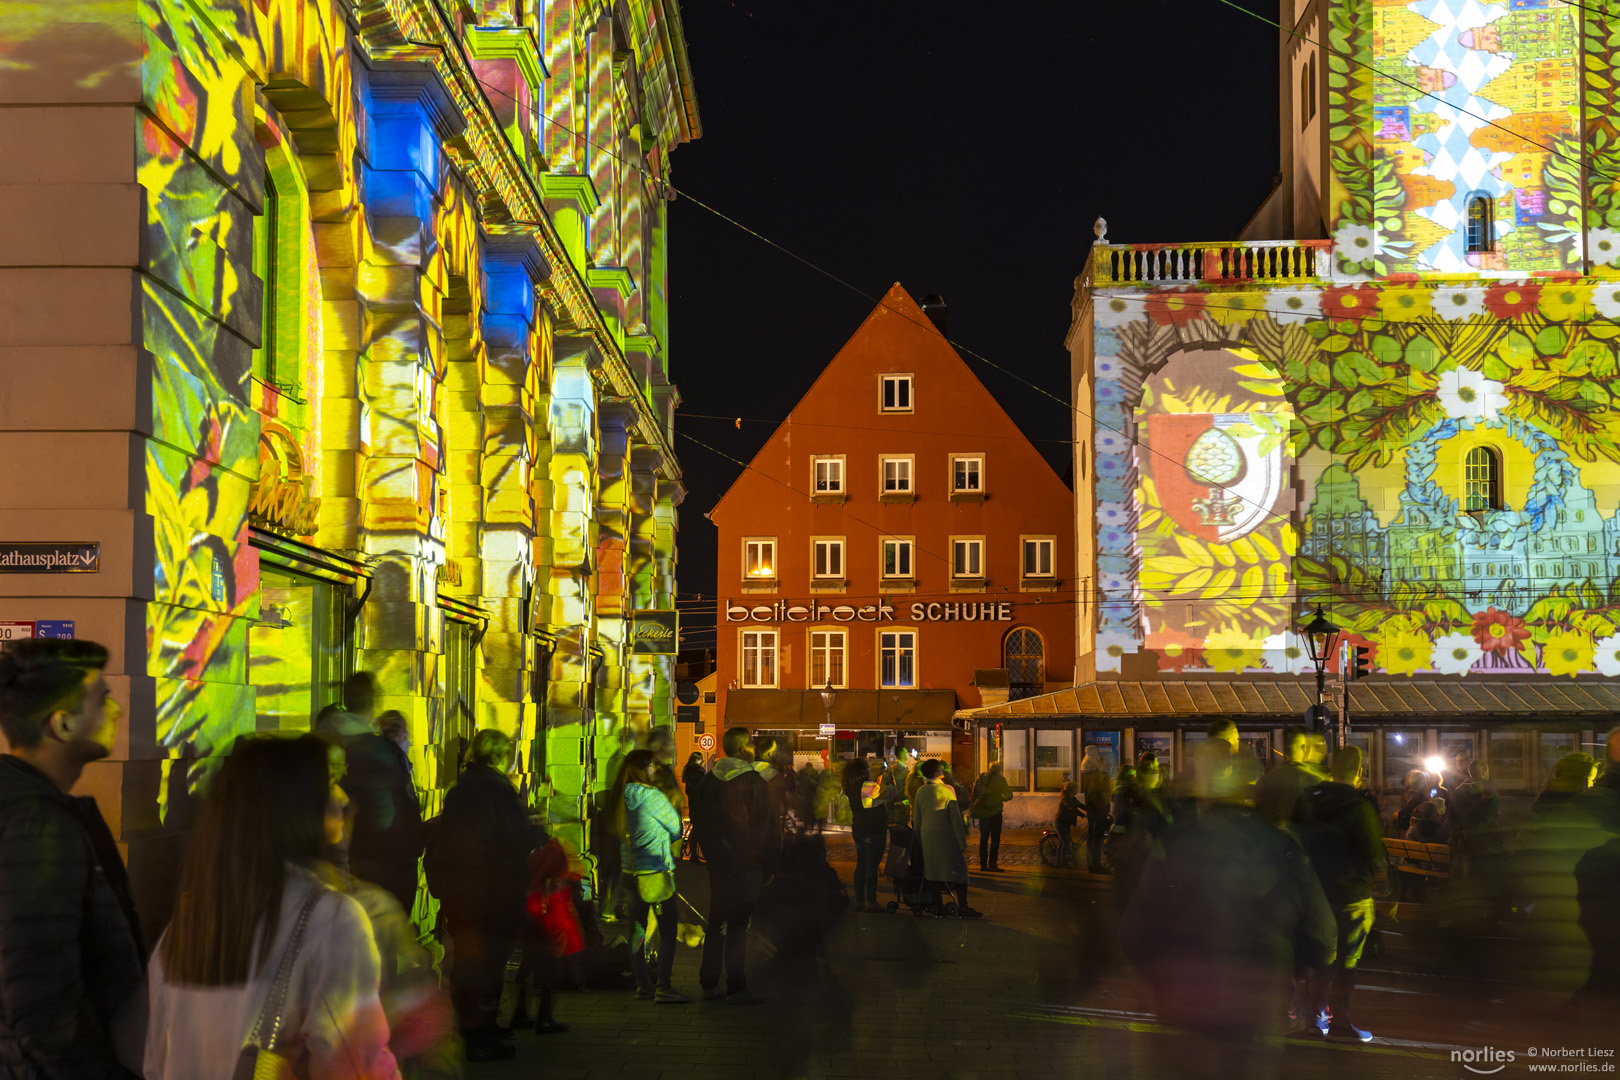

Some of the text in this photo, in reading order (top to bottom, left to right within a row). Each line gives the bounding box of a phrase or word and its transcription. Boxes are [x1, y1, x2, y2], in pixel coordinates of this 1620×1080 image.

[726, 599, 1012, 621] beitelrock SCHUHE
[636, 623, 674, 638] Eckerle
[702, 738, 712, 747] 30
